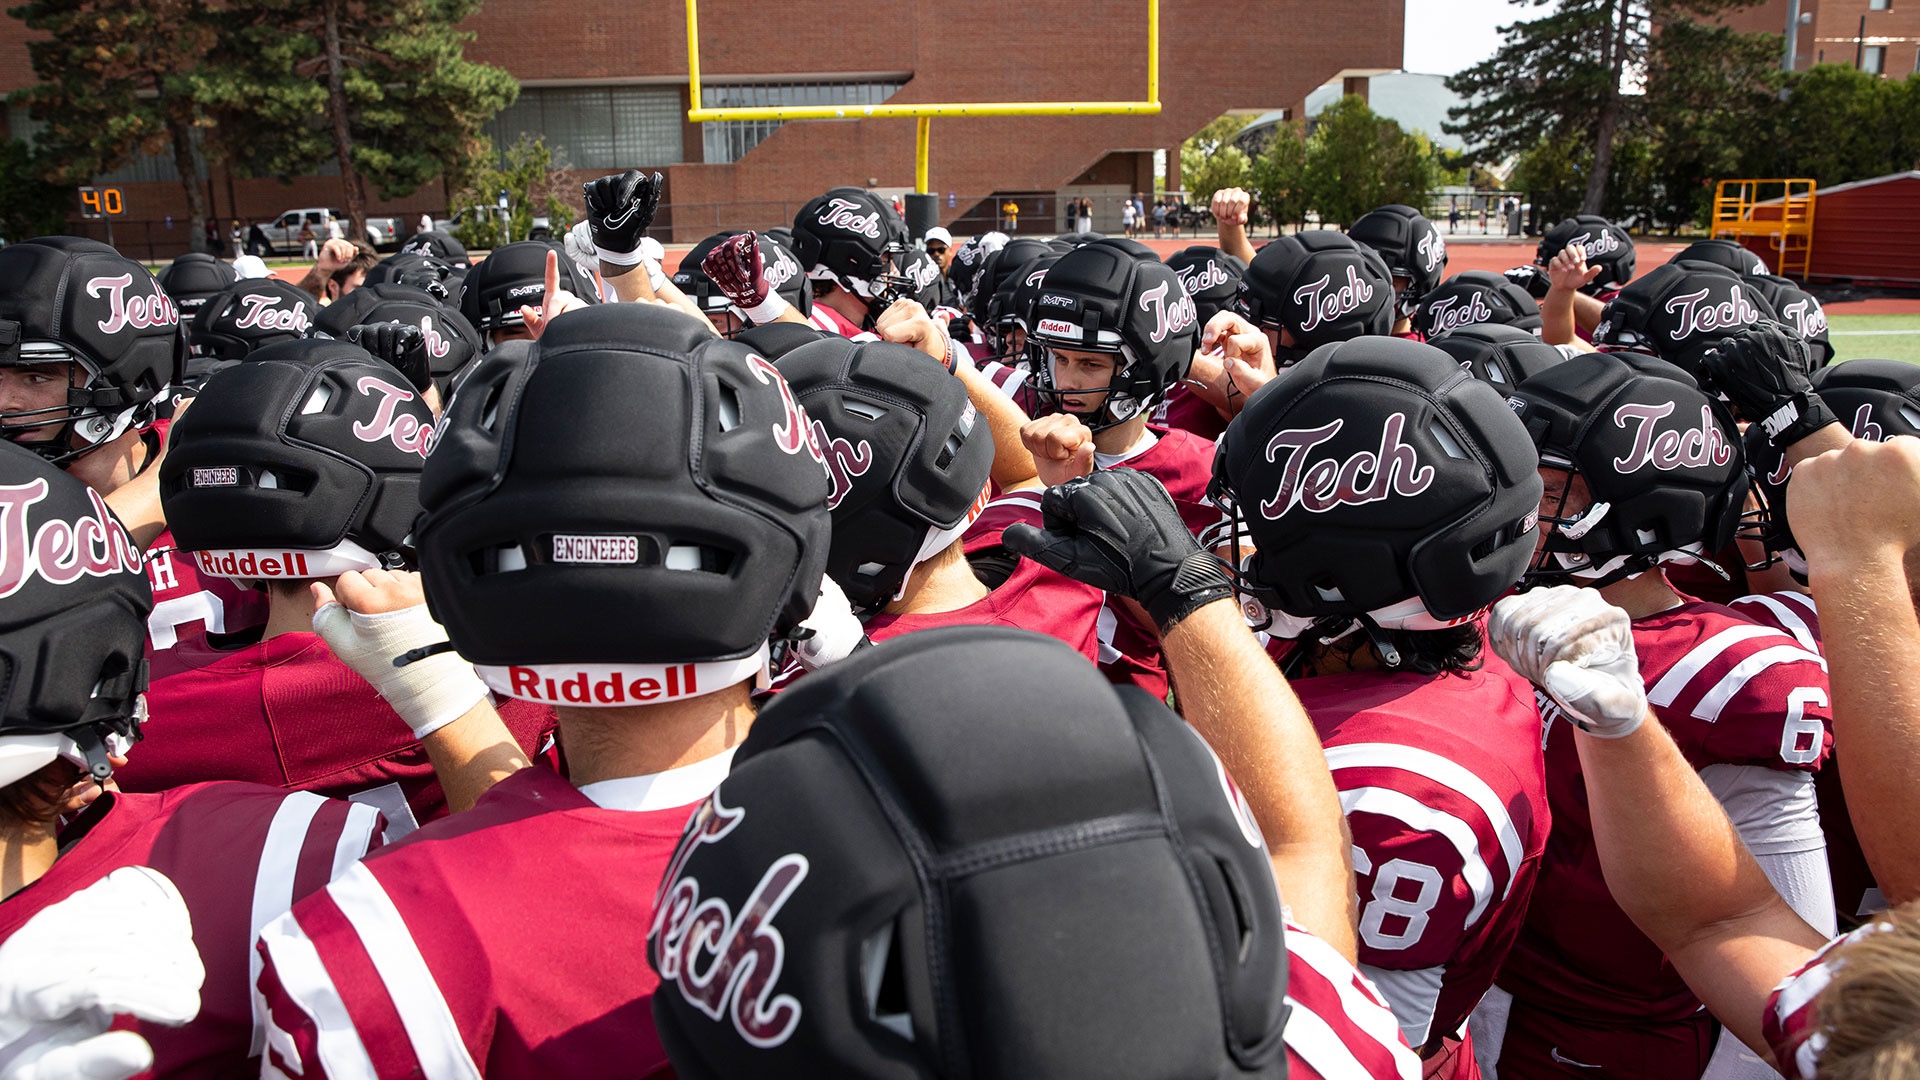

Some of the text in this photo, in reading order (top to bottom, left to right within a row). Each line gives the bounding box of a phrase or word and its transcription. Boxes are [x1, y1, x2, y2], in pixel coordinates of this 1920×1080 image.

[82, 189, 122, 214] 40
[819, 198, 880, 238] Tech
[86, 273, 178, 334] Tech
[236, 294, 312, 333] Tech
[1043, 295, 1073, 307] MIT
[1294, 265, 1373, 332] Tech
[1428, 291, 1492, 336] Tech
[1665, 284, 1758, 341] Tech
[1040, 320, 1071, 334] Riddell
[353, 376, 434, 459] Tec
[1614, 401, 1731, 474] Tech
[1761, 400, 1799, 439] NIKE
[193, 467, 238, 486] ENGINEERS
[1260, 412, 1435, 520] Tech
[0, 477, 143, 599] Tech
[552, 534, 638, 564] ENGINEERS
[201, 551, 309, 576] Riddell
[508, 664, 698, 704] Riddell
[1780, 687, 1828, 763] 6
